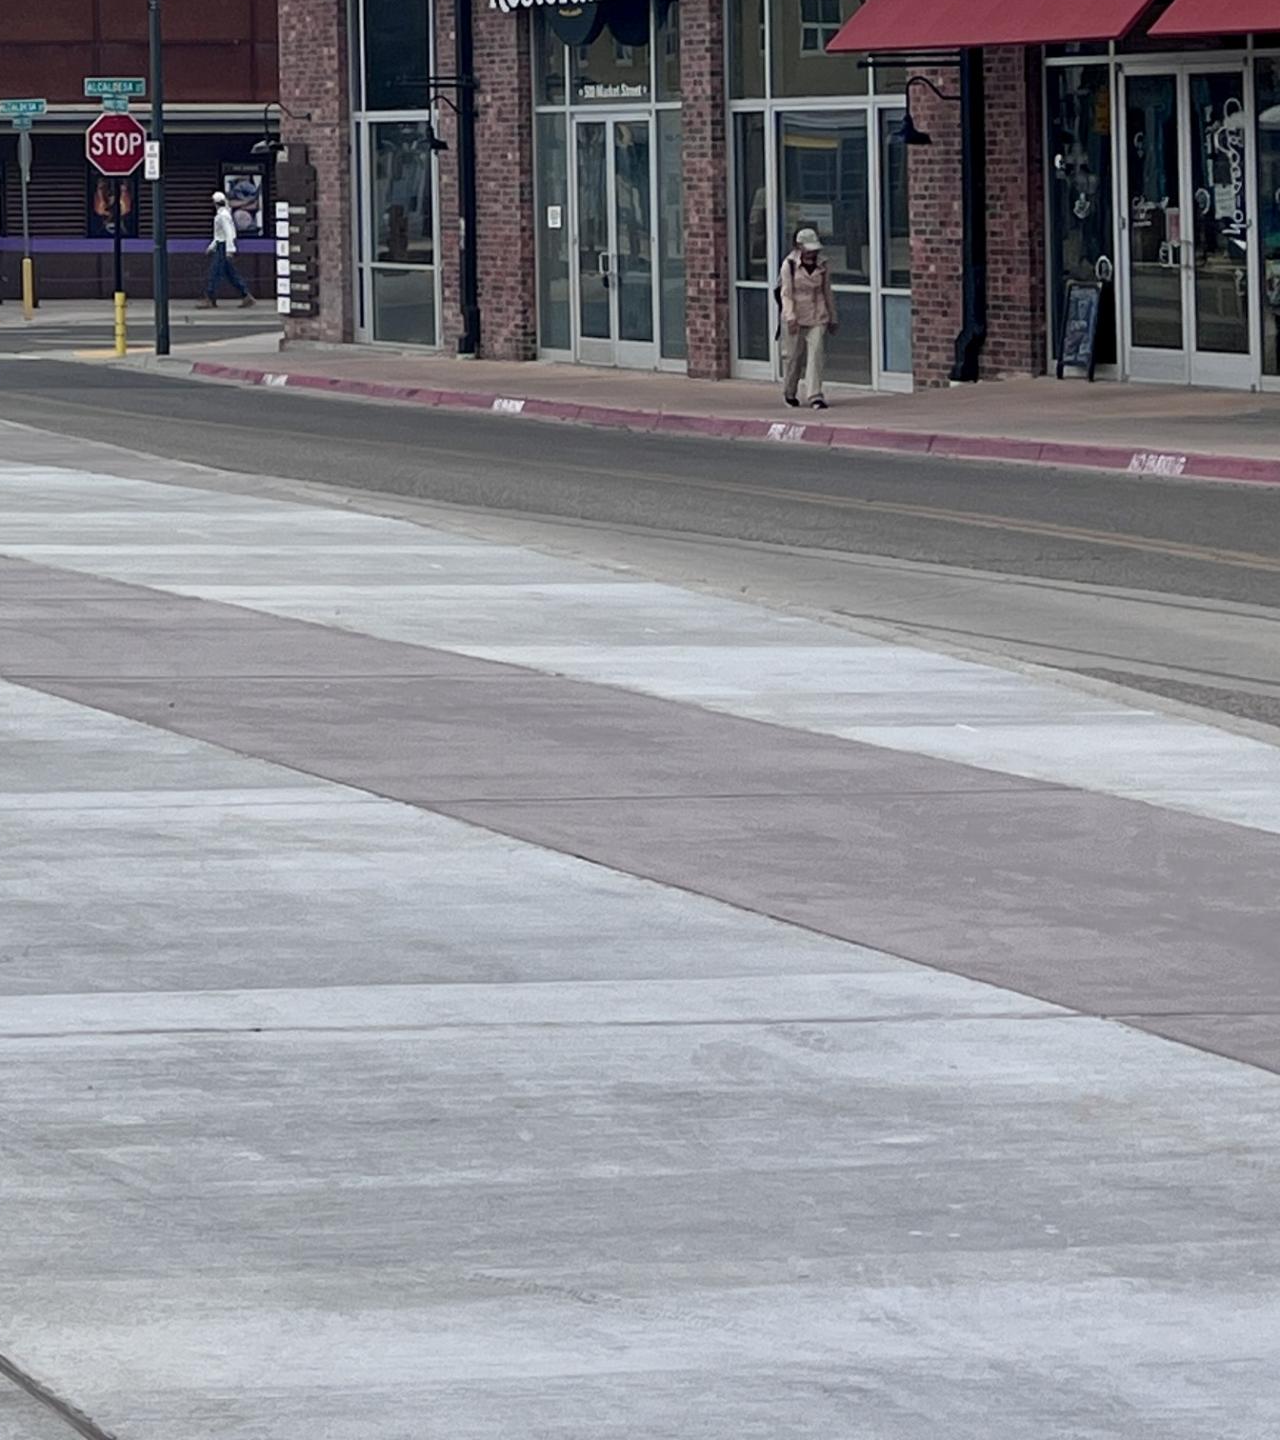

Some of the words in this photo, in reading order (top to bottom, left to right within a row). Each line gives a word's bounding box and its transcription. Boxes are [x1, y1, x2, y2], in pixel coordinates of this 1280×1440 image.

[87, 81, 133, 92] ALCALDESA
[596, 83, 621, 97] Market
[621, 82, 642, 97] Street
[91, 132, 142, 156] STOP
